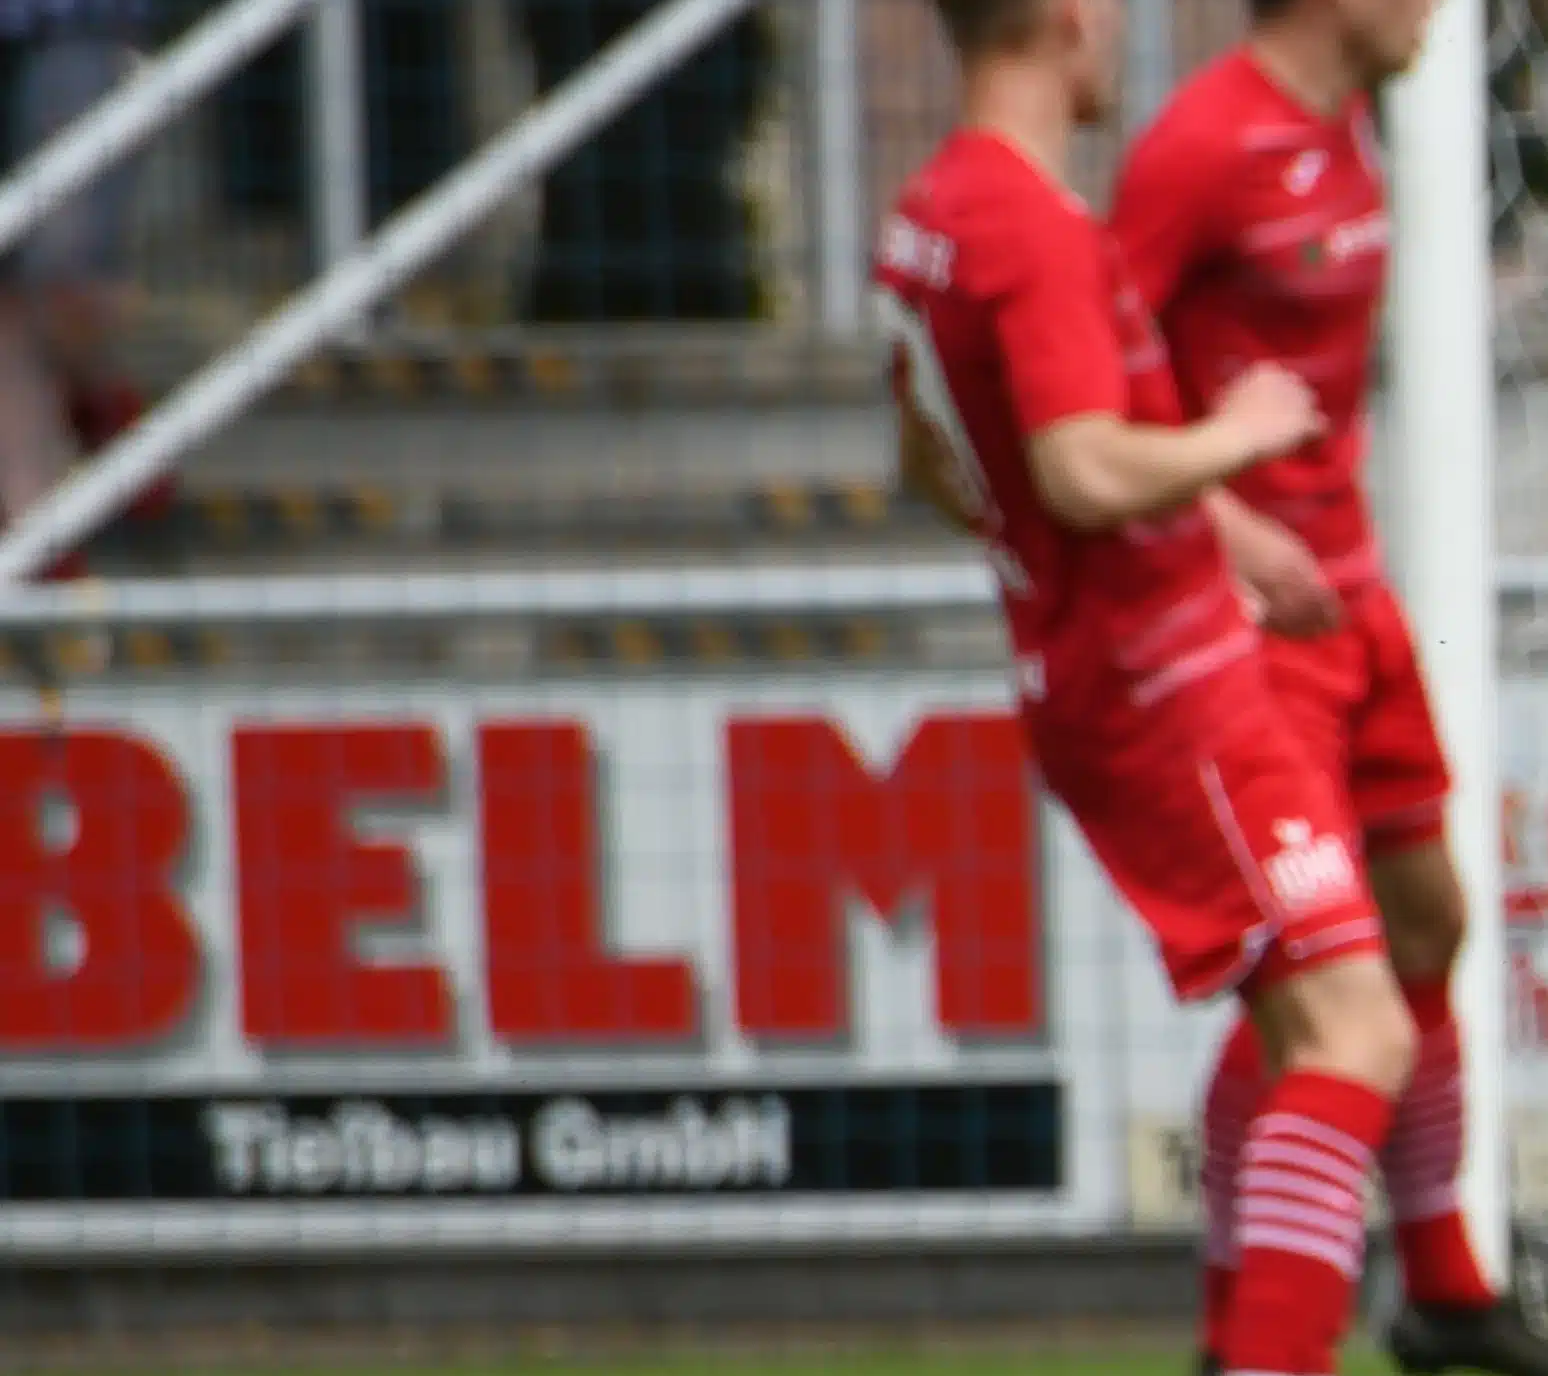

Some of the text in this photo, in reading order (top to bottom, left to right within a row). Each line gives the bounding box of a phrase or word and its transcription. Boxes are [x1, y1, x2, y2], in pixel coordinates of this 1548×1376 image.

[0, 716, 1045, 1044] BELM
[205, 1094, 794, 1193] Tiefbau GmbH
